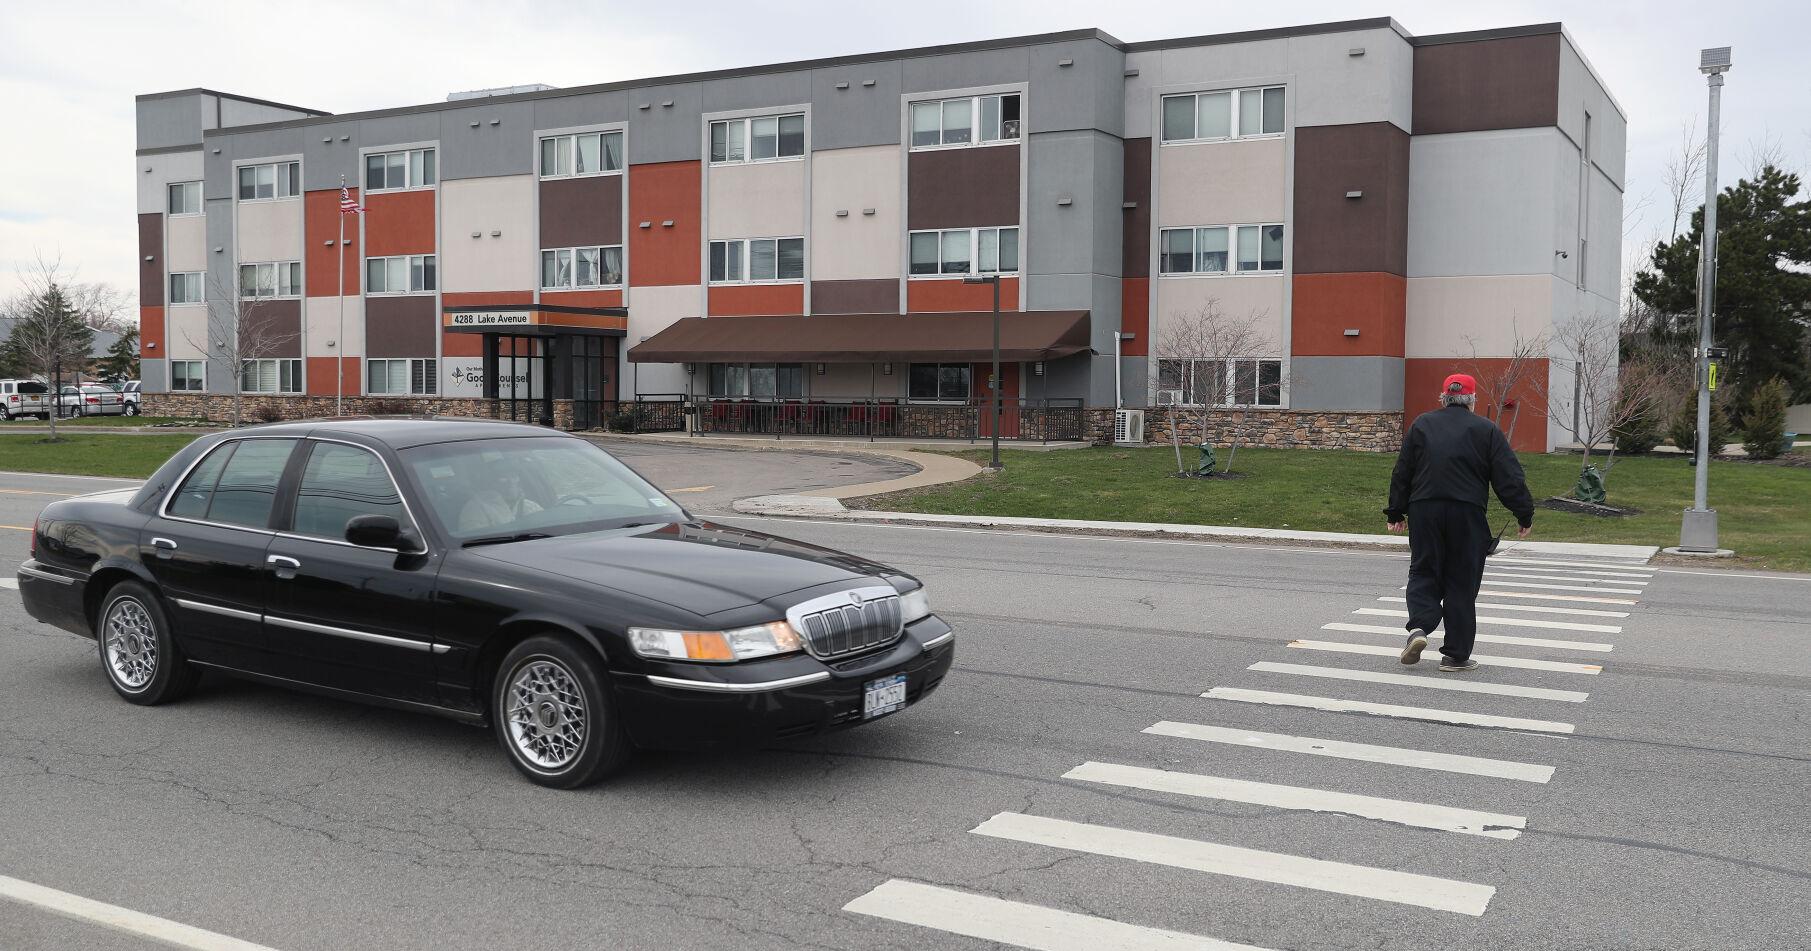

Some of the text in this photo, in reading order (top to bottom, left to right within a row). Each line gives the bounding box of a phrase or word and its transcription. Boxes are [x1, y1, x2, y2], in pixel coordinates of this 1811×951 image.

[454, 314, 527, 324] 4288 Lake Avenue
[466, 372, 484, 382] Goo
